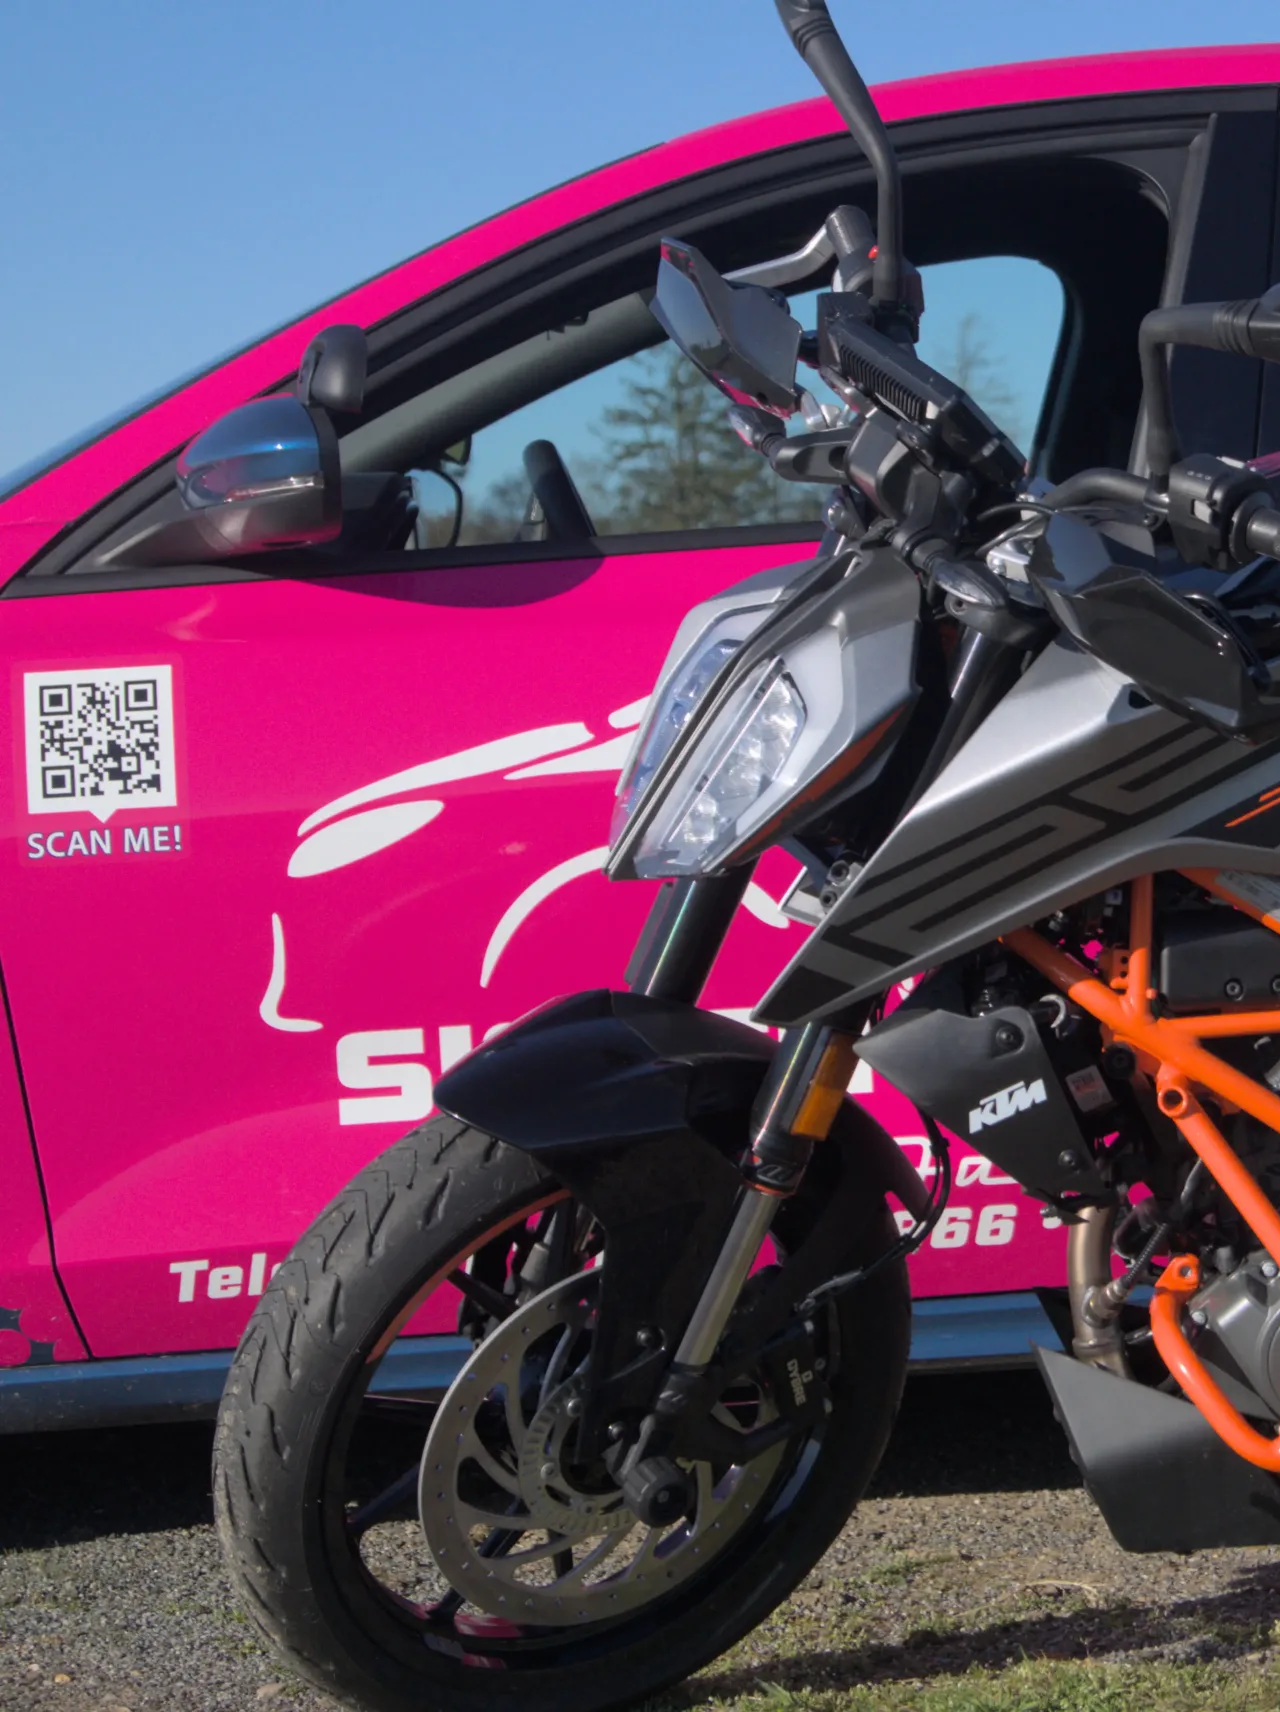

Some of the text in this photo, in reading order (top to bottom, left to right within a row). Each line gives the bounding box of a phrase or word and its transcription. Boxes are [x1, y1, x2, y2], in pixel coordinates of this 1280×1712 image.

[27, 825, 182, 859] SCAN ME!
[969, 1078, 1048, 1135] KTM
[169, 1252, 283, 1303] Tel
